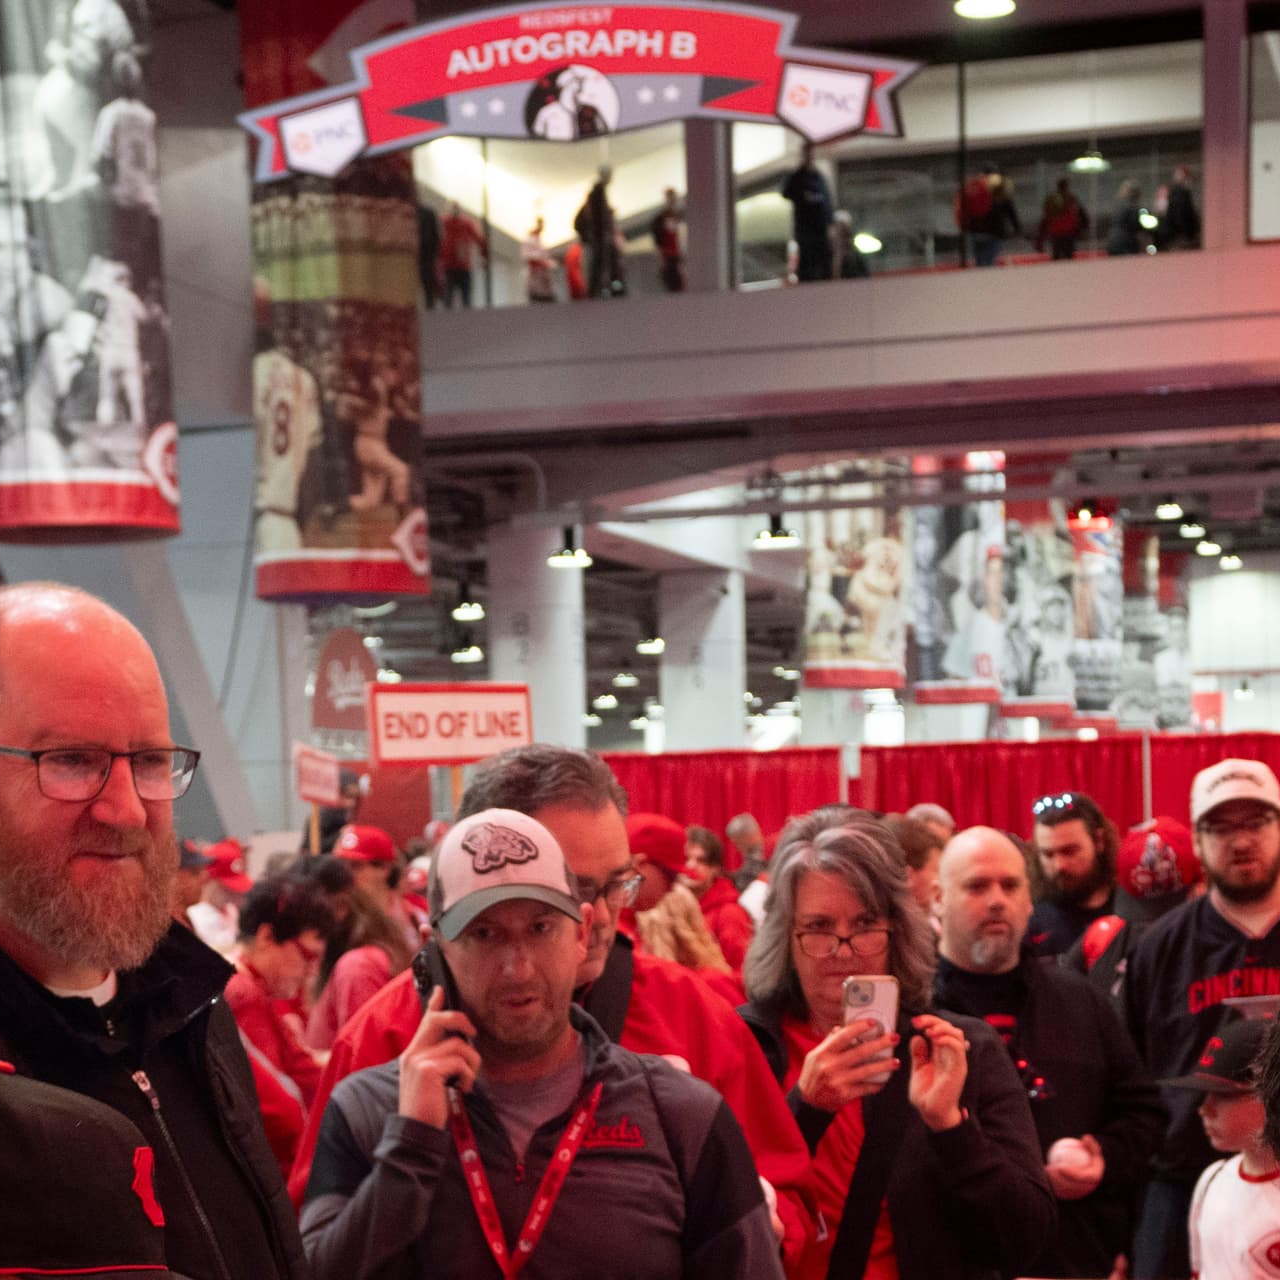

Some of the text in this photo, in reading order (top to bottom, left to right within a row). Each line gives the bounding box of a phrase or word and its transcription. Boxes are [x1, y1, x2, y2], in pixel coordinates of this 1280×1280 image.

[446, 29, 698, 78] AUTOGRAPH B
[384, 711, 522, 740] END OF LINE
